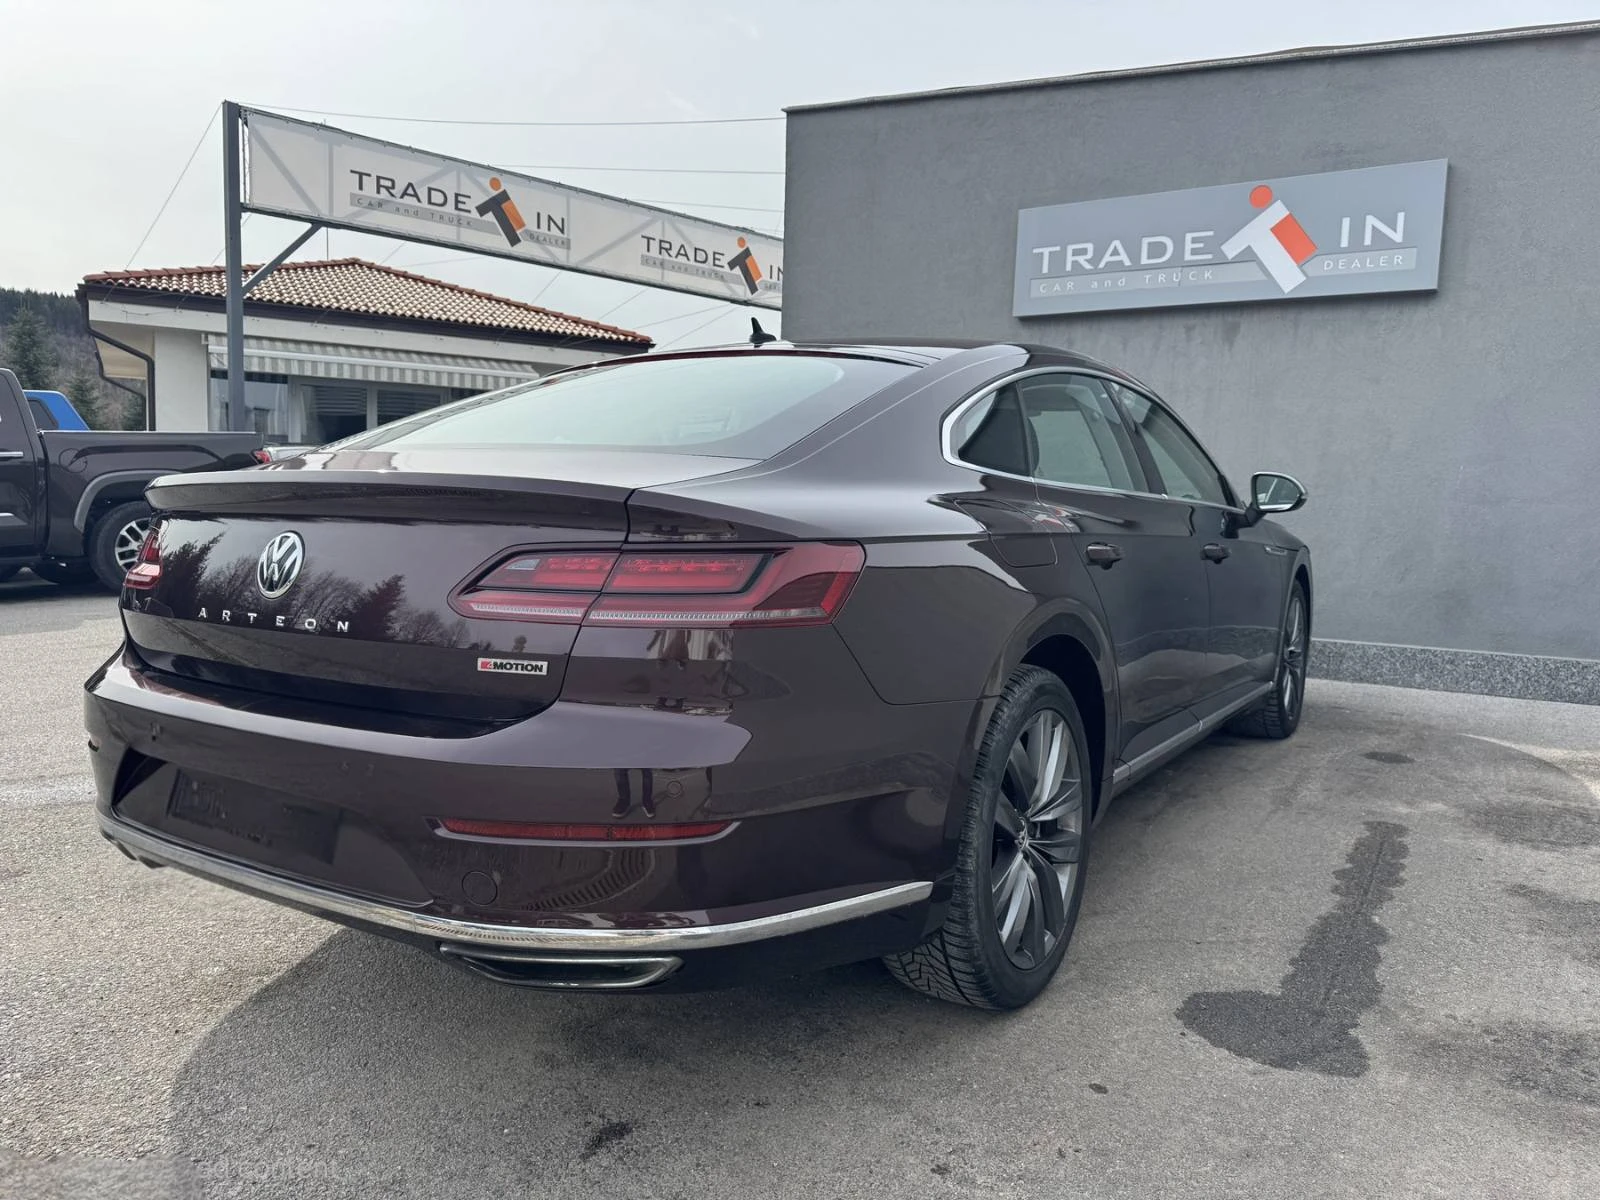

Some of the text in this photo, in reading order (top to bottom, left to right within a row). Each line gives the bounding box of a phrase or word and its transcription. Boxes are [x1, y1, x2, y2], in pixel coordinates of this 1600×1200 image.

[349, 169, 472, 214] TRADE
[536, 211, 565, 235] IN
[356, 198, 384, 209] CAR
[394, 206, 419, 217] and
[430, 212, 474, 226] TRUCK
[640, 234, 726, 269] TRADE
[1032, 231, 1215, 274] TRADE
[1339, 211, 1406, 248] IN
[1038, 254, 1404, 294] CAR and TRUCK DEALER
[197, 606, 350, 633] ARTEON
[480, 660, 544, 673] 4MOTION
